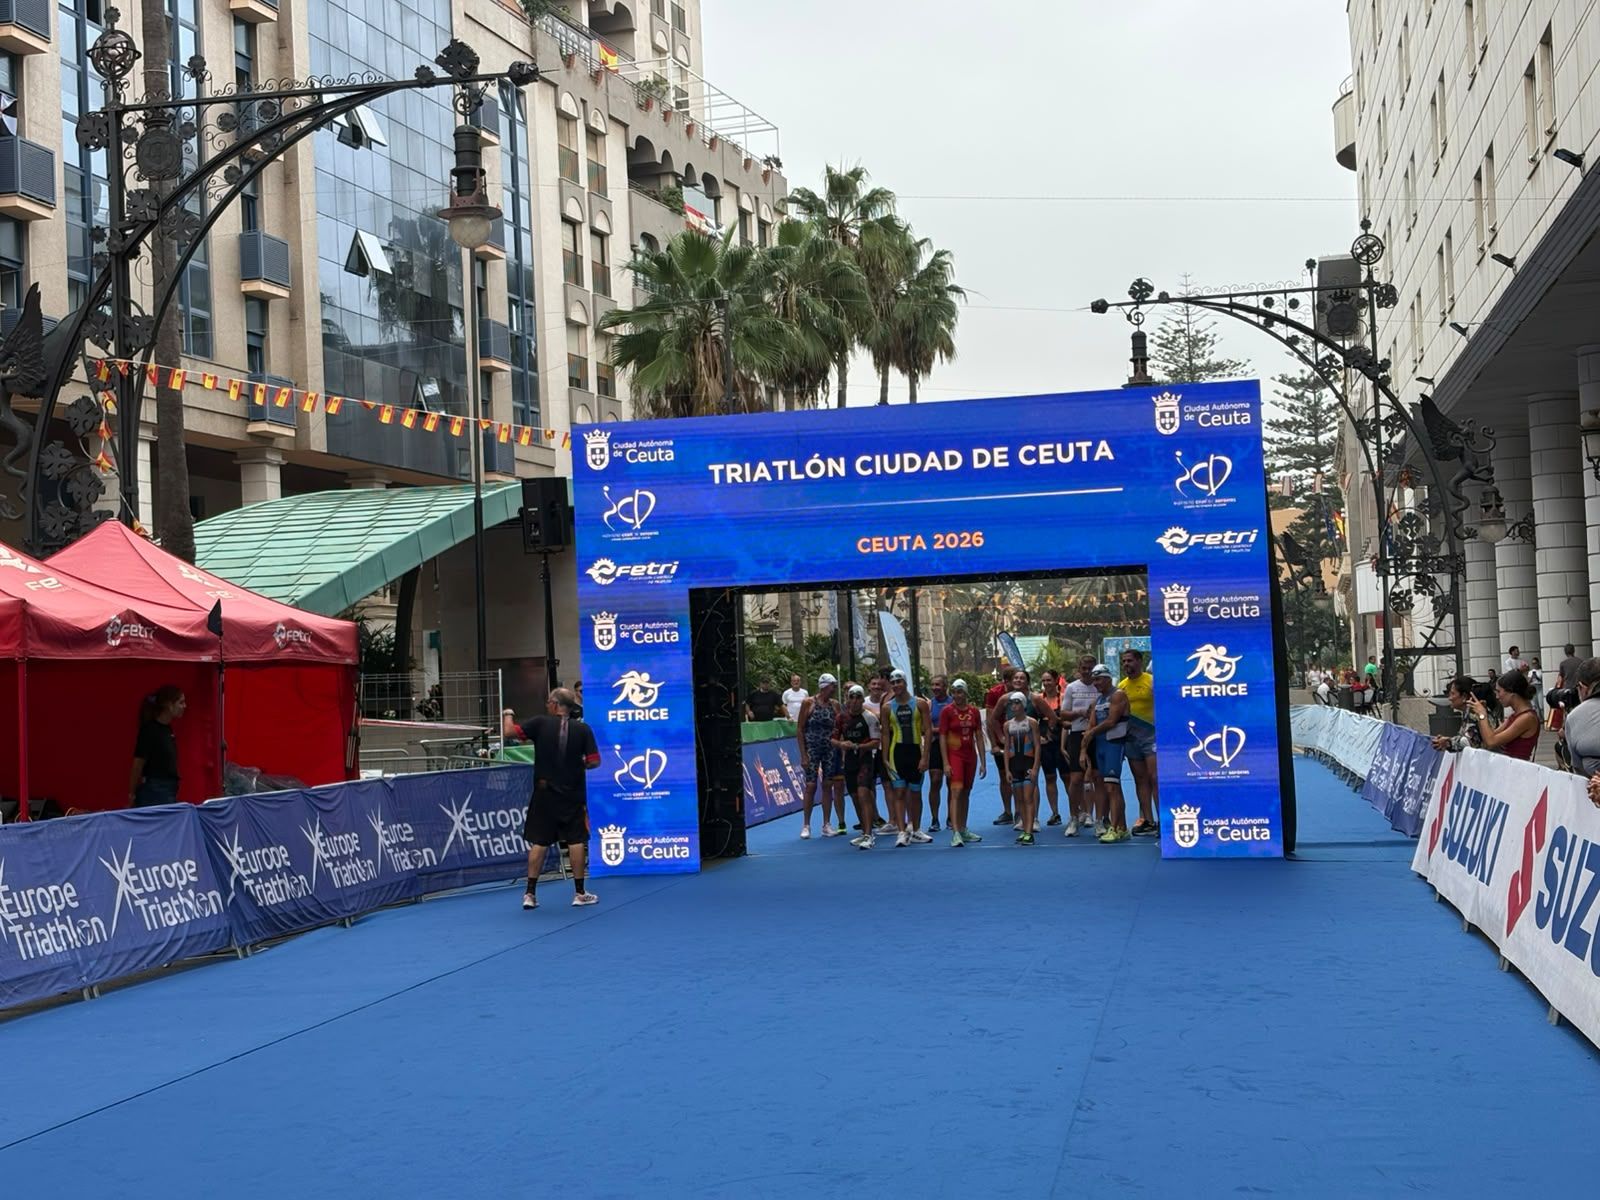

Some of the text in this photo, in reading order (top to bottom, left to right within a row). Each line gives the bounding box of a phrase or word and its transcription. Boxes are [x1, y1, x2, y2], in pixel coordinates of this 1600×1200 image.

[1183, 404, 1210, 413] Ciudad
[1183, 410, 1252, 428] de Ceuta
[612, 441, 637, 450] Ciudad
[612, 447, 675, 464] de Ceuta
[708, 439, 1115, 485] TRIATLÓN CIUDAD DE CEUTA
[856, 531, 985, 554] CEUTA 2026
[1192, 597, 1219, 606] Ciudad
[1192, 602, 1261, 620] de Ceuta
[619, 622, 643, 631] Ciudad
[619, 629, 680, 645] de Ceuta
[1181, 683, 1248, 698] FETRICE
[607, 708, 669, 723] FETRICE
[1202, 818, 1229, 828] Ciudad
[627, 837, 653, 846] Ciudad
[1202, 824, 1271, 843] de Ceuta
[1440, 781, 1510, 887] SUZUKI
[318, 831, 361, 859] Europe
[627, 844, 691, 862] de Ceuta
[236, 845, 291, 876] Europe
[126, 858, 198, 895] Europe
[243, 871, 313, 907] Triathlon
[0, 882, 80, 920] Europe
[135, 889, 224, 931] Triathlon
[8, 915, 108, 961] Triathlon
